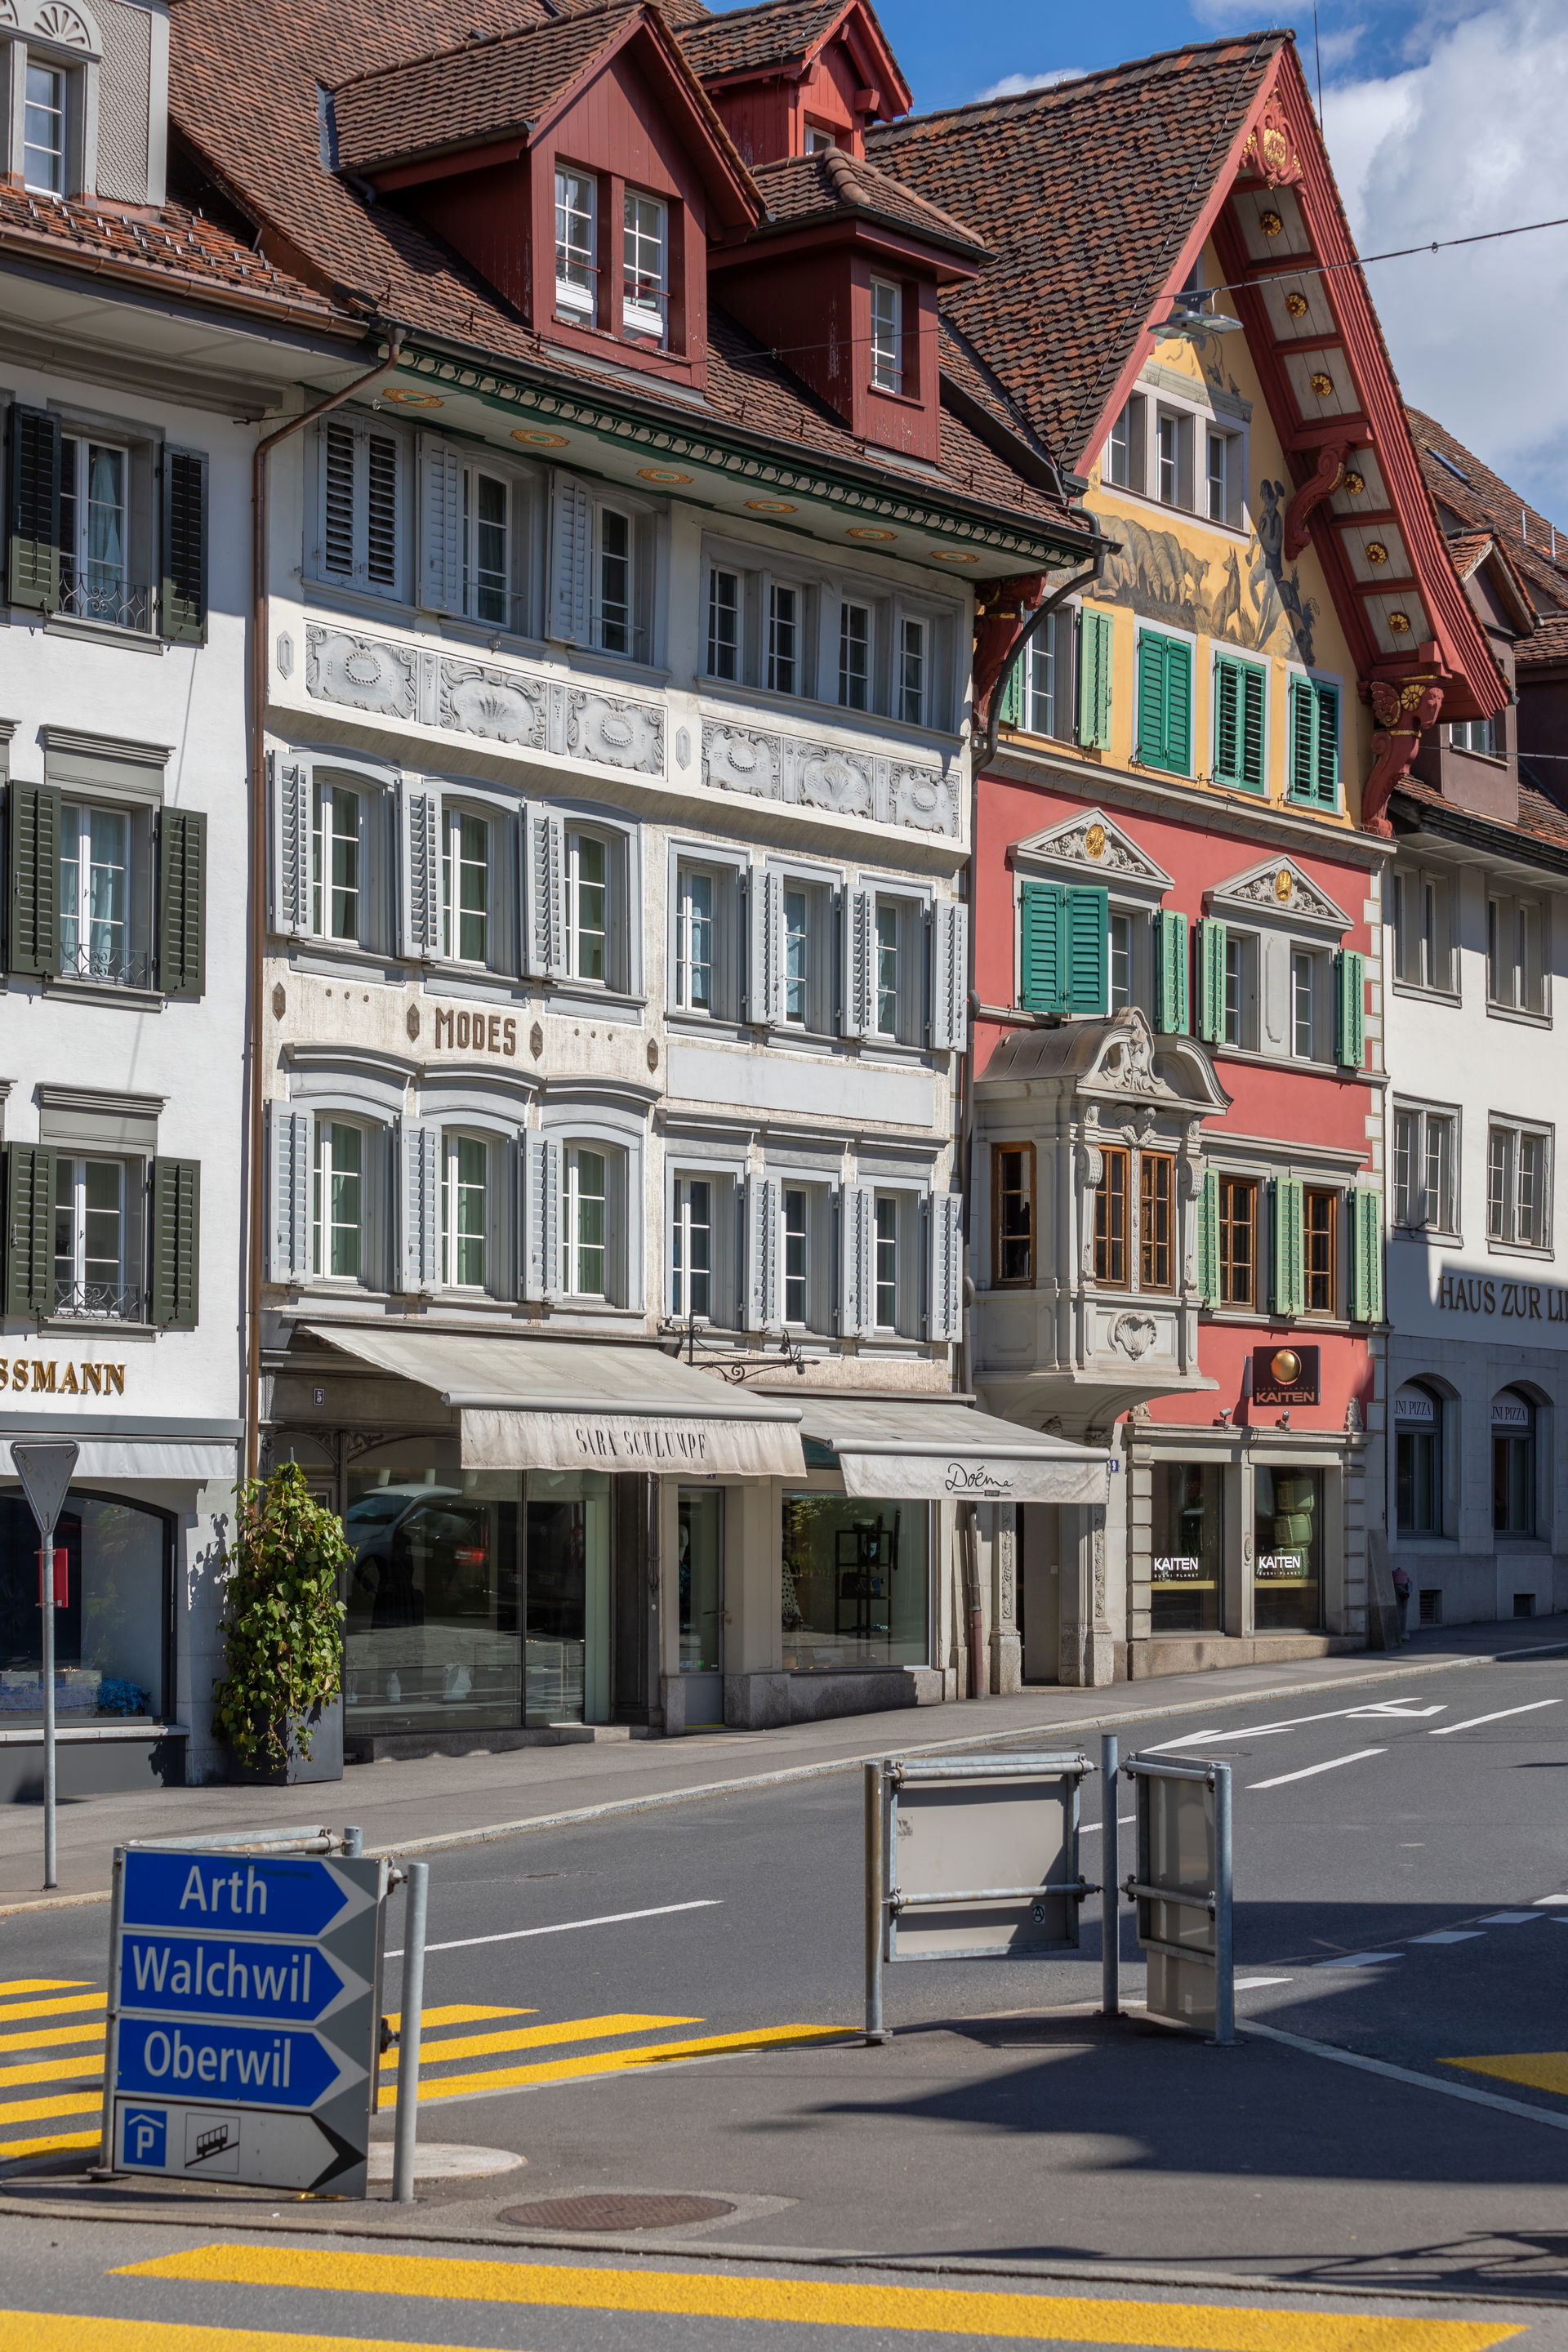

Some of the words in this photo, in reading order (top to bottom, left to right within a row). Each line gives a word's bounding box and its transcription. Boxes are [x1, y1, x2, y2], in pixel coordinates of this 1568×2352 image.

[435, 1007, 516, 1056] MODES
[1438, 1275, 1496, 1315] HAUS
[1501, 1283, 1543, 1319] ZUR
[316, 1391, 322, 1403] 5
[1256, 1392, 1315, 1403] KAITEN
[1409, 1401, 1432, 1416] PIZZA
[1504, 1406, 1526, 1421] PIZZA
[576, 1428, 619, 1456] SARA
[623, 1430, 706, 1459] SCHLUMPF
[1154, 1557, 1199, 1570] KAITEN
[1258, 1556, 1301, 1569] KAITEN
[179, 1865, 268, 1915] Arth
[132, 1945, 311, 2002] Walchwil
[144, 2029, 291, 2088] Oberwil
[136, 2125, 155, 2159] P
